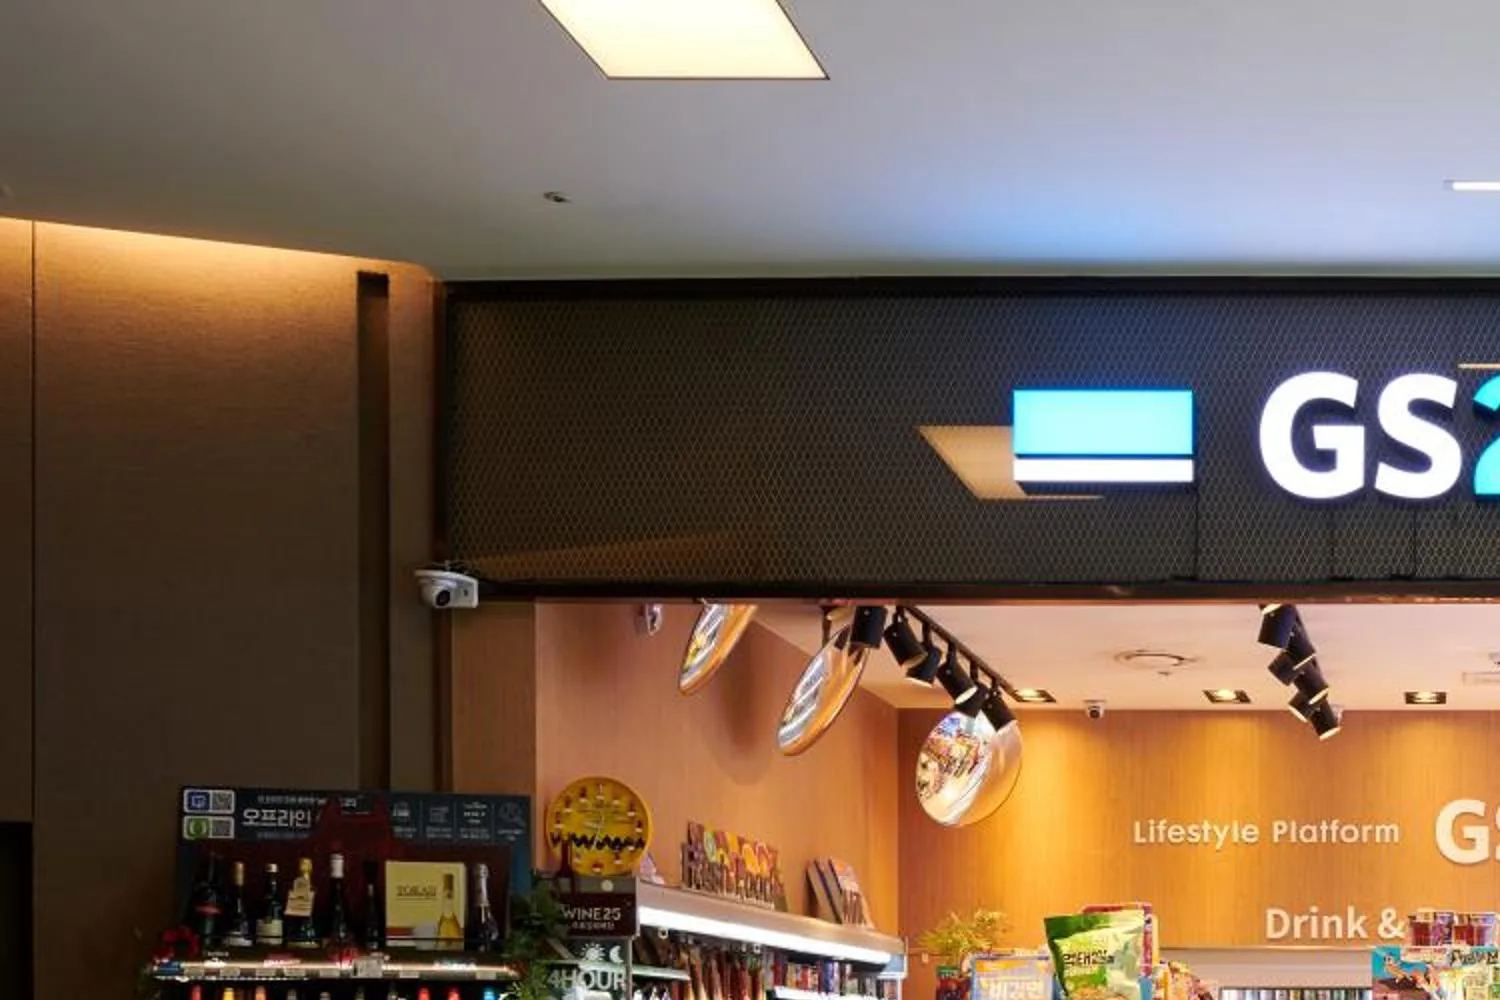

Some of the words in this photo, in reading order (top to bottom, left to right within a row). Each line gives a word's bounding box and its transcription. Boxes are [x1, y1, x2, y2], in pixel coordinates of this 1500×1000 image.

[242, 808, 311, 828] 오프라인
[1133, 819, 1260, 851] Lifestyle
[1273, 819, 1400, 844] Platform
[1265, 905, 1368, 940] Drink
[1378, 907, 1405, 940] &
[547, 968, 627, 991] 4HOUR
